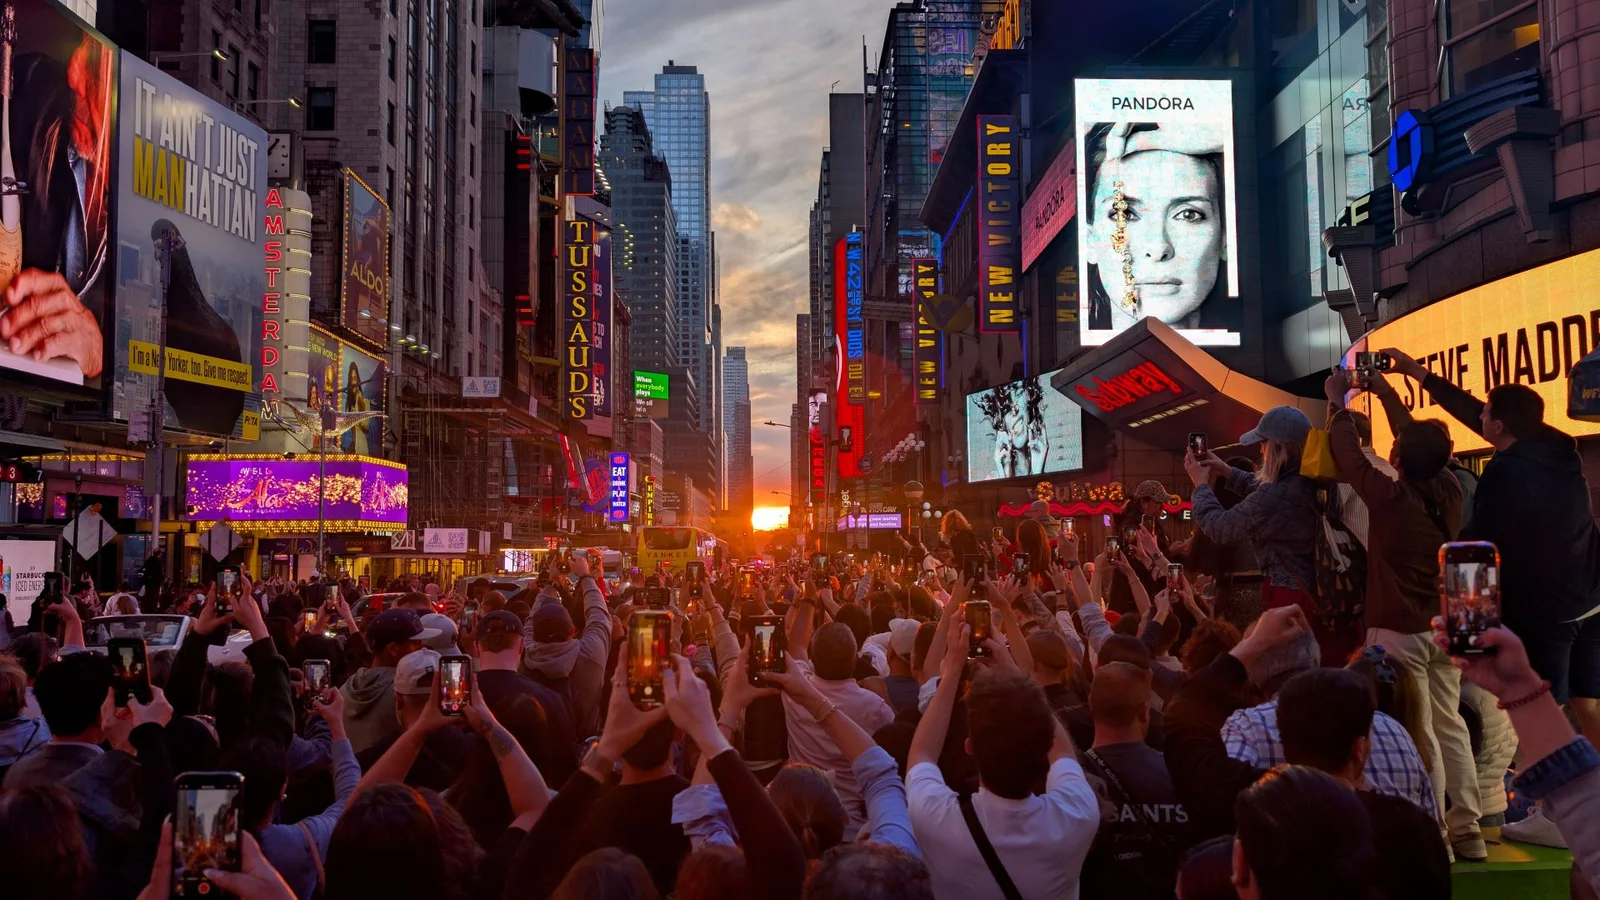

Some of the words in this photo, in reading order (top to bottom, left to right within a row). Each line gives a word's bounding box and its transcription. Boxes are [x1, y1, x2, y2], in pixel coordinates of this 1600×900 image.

[1111, 97, 1195, 110] PANDORA
[135, 76, 156, 140] IT
[159, 92, 214, 170] AIN'T
[216, 123, 258, 191] JUST
[133, 136, 257, 243] MANHATTAN
[986, 123, 1012, 246] VICTORY
[1035, 185, 1065, 232] PANDORA
[350, 259, 383, 296] ALDO
[848, 262, 861, 289] 42
[918, 264, 936, 347] VICORY
[989, 265, 1014, 324] NEW
[568, 221, 590, 419] TUSSAUD'S
[848, 307, 863, 357] STDIOS
[133, 345, 144, 365] I'm
[145, 353, 151, 364] a
[151, 349, 165, 369] Ne
[167, 351, 190, 375] Yorker,
[190, 359, 203, 377] too.
[203, 359, 217, 379] Give
[217, 366, 227, 381] me
[227, 367, 250, 386] respect.
[636, 376, 652, 384] When
[848, 363, 862, 392] DUE
[920, 360, 936, 399] NEW
[636, 384, 664, 392] everybody
[636, 389, 651, 397] plays
[1074, 360, 1183, 412] Subway
[9, 467, 16, 479] 3
[36, 470, 43, 481] 7
[612, 467, 626, 477] EAT
[612, 490, 626, 498] PLAY
[28, 580, 44, 592] ENER
[1110, 803, 1189, 823] ANTS
[1115, 850, 1142, 861] LONDON
